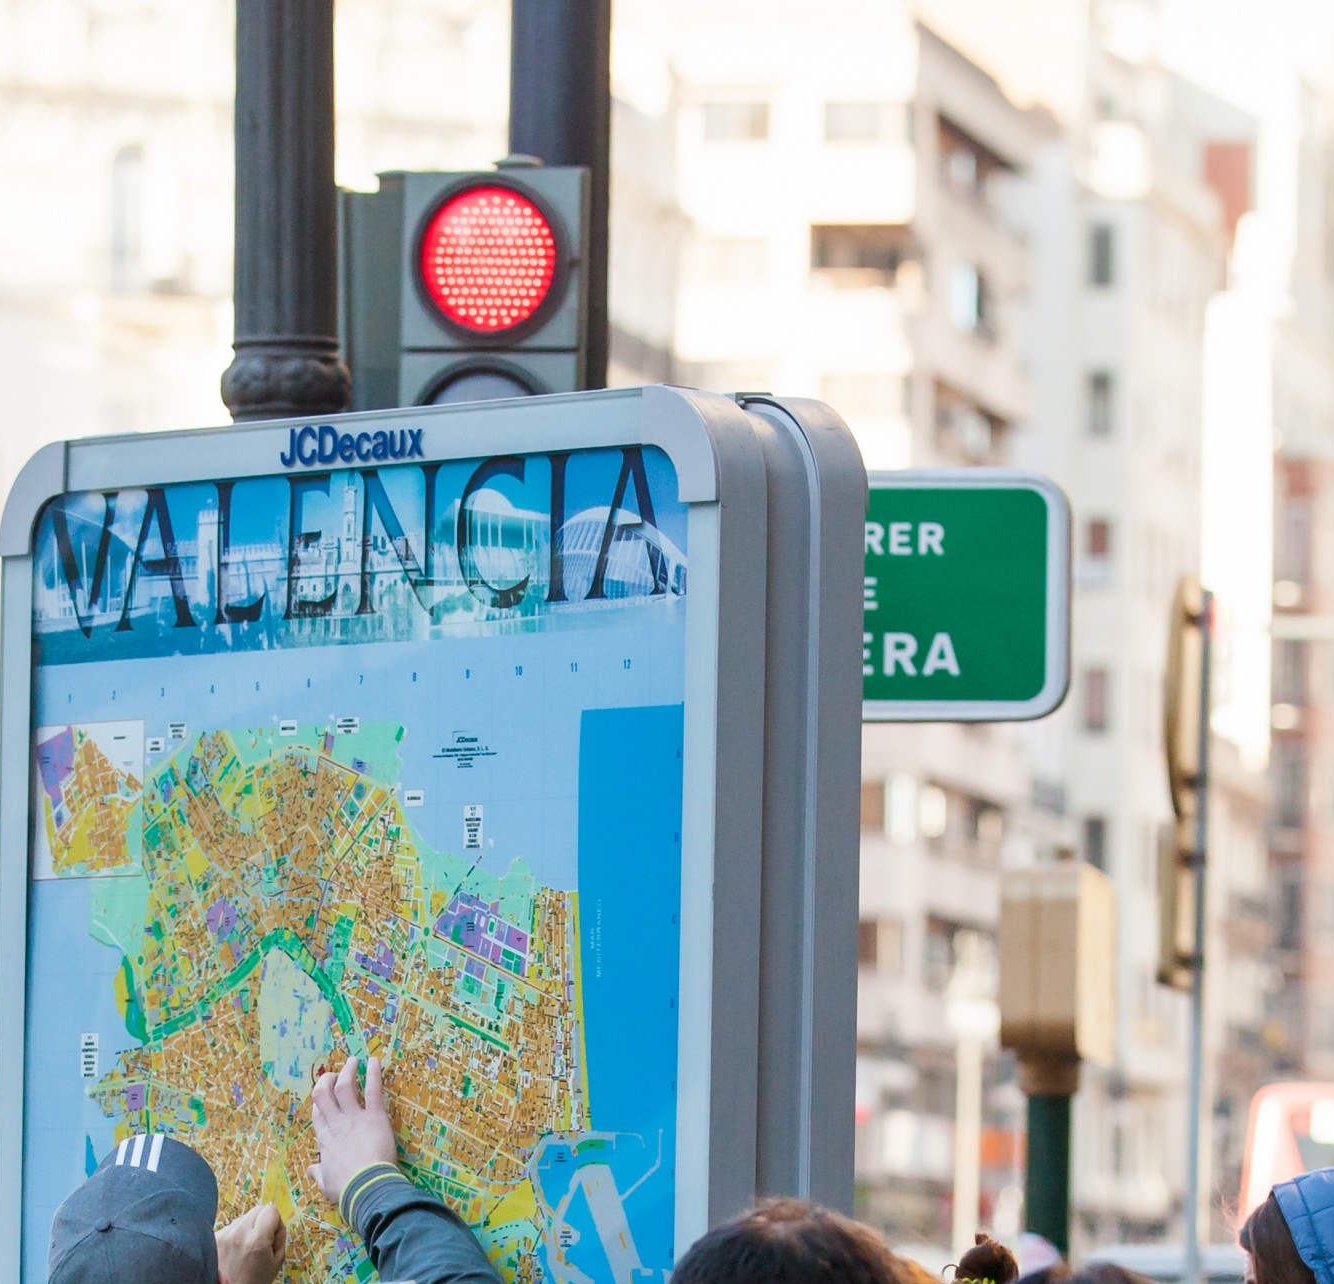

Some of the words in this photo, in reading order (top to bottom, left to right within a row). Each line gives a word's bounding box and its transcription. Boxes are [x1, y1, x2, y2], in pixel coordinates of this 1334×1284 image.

[280, 425, 423, 467] JCDecaux
[49, 443, 668, 639] VALENCIA
[515, 665, 523, 676] 10
[570, 662, 578, 672] 11
[623, 659, 631, 669] 12
